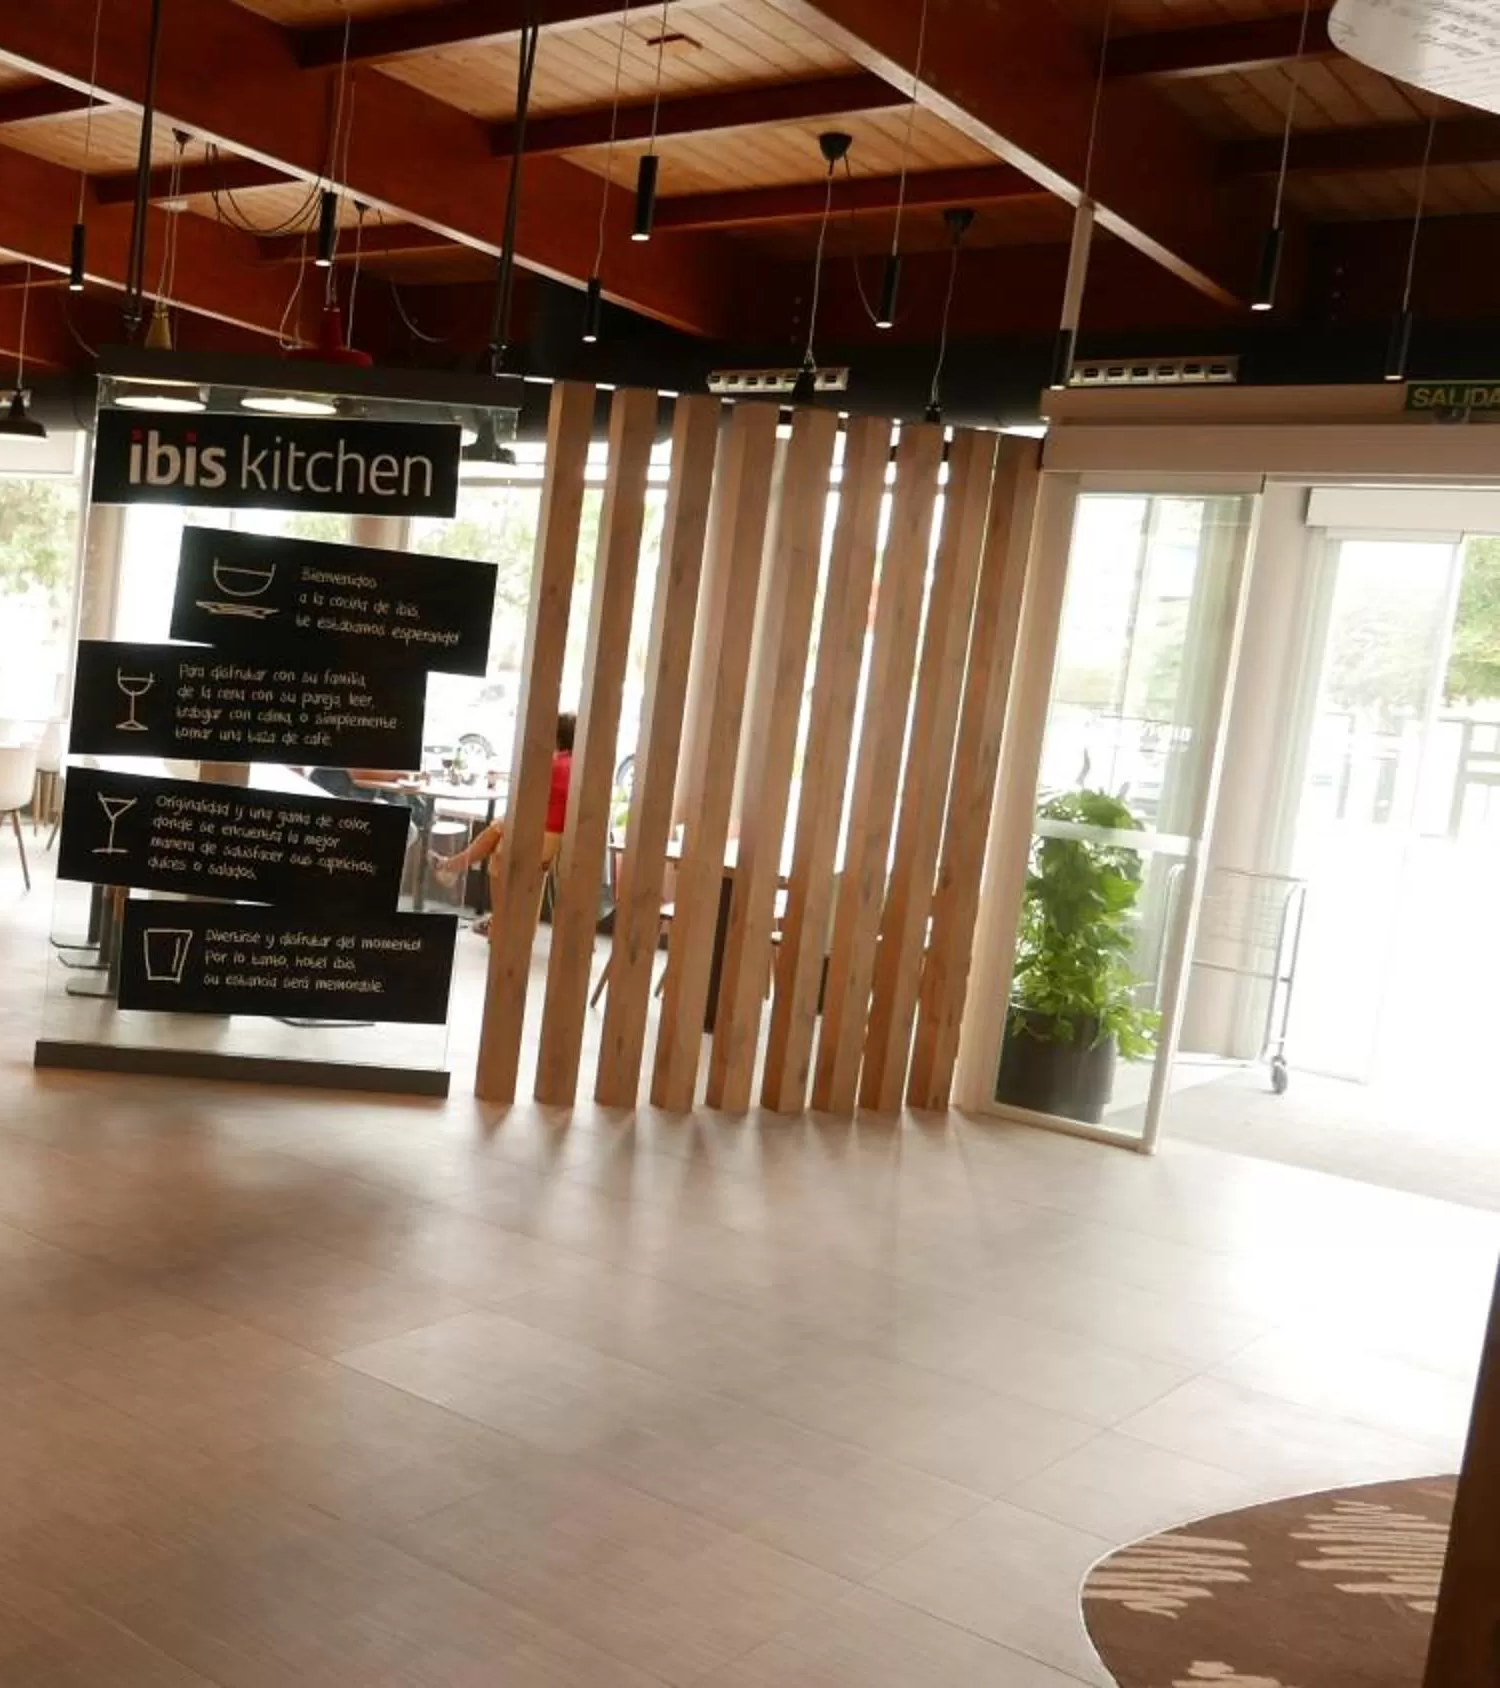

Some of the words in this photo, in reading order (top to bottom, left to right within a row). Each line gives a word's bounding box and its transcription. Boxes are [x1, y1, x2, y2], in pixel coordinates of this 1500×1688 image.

[129, 429, 227, 489] ibis
[241, 434, 433, 498] kitchen
[301, 565, 378, 589] Bienvenidos
[299, 592, 307, 604] a
[373, 600, 391, 615] de
[179, 663, 205, 680] Para
[210, 664, 267, 681] disfrutar
[272, 669, 296, 682] con
[301, 670, 318, 684] su
[176, 684, 196, 700] de
[251, 688, 273, 702] con
[279, 691, 297, 704] su
[229, 709, 251, 721] con
[299, 712, 309, 723] o
[315, 711, 398, 732] simplemente
[175, 724, 213, 740] tomar
[219, 729, 242, 742] una
[281, 731, 299, 747] de
[155, 795, 230, 817] Originalidad
[235, 803, 244, 821] y
[249, 806, 273, 822] una
[315, 815, 333, 829] de
[152, 814, 193, 833] donde
[199, 821, 215, 834] se
[303, 834, 341, 853] mejor
[150, 836, 195, 853] manera
[200, 841, 217, 857] de
[147, 855, 187, 872] dulces
[193, 861, 203, 872] o
[264, 932, 276, 950] y
[279, 930, 331, 948] disfrutar
[204, 949, 229, 965] Por
[232, 950, 246, 965] lo
[203, 974, 220, 986] su
